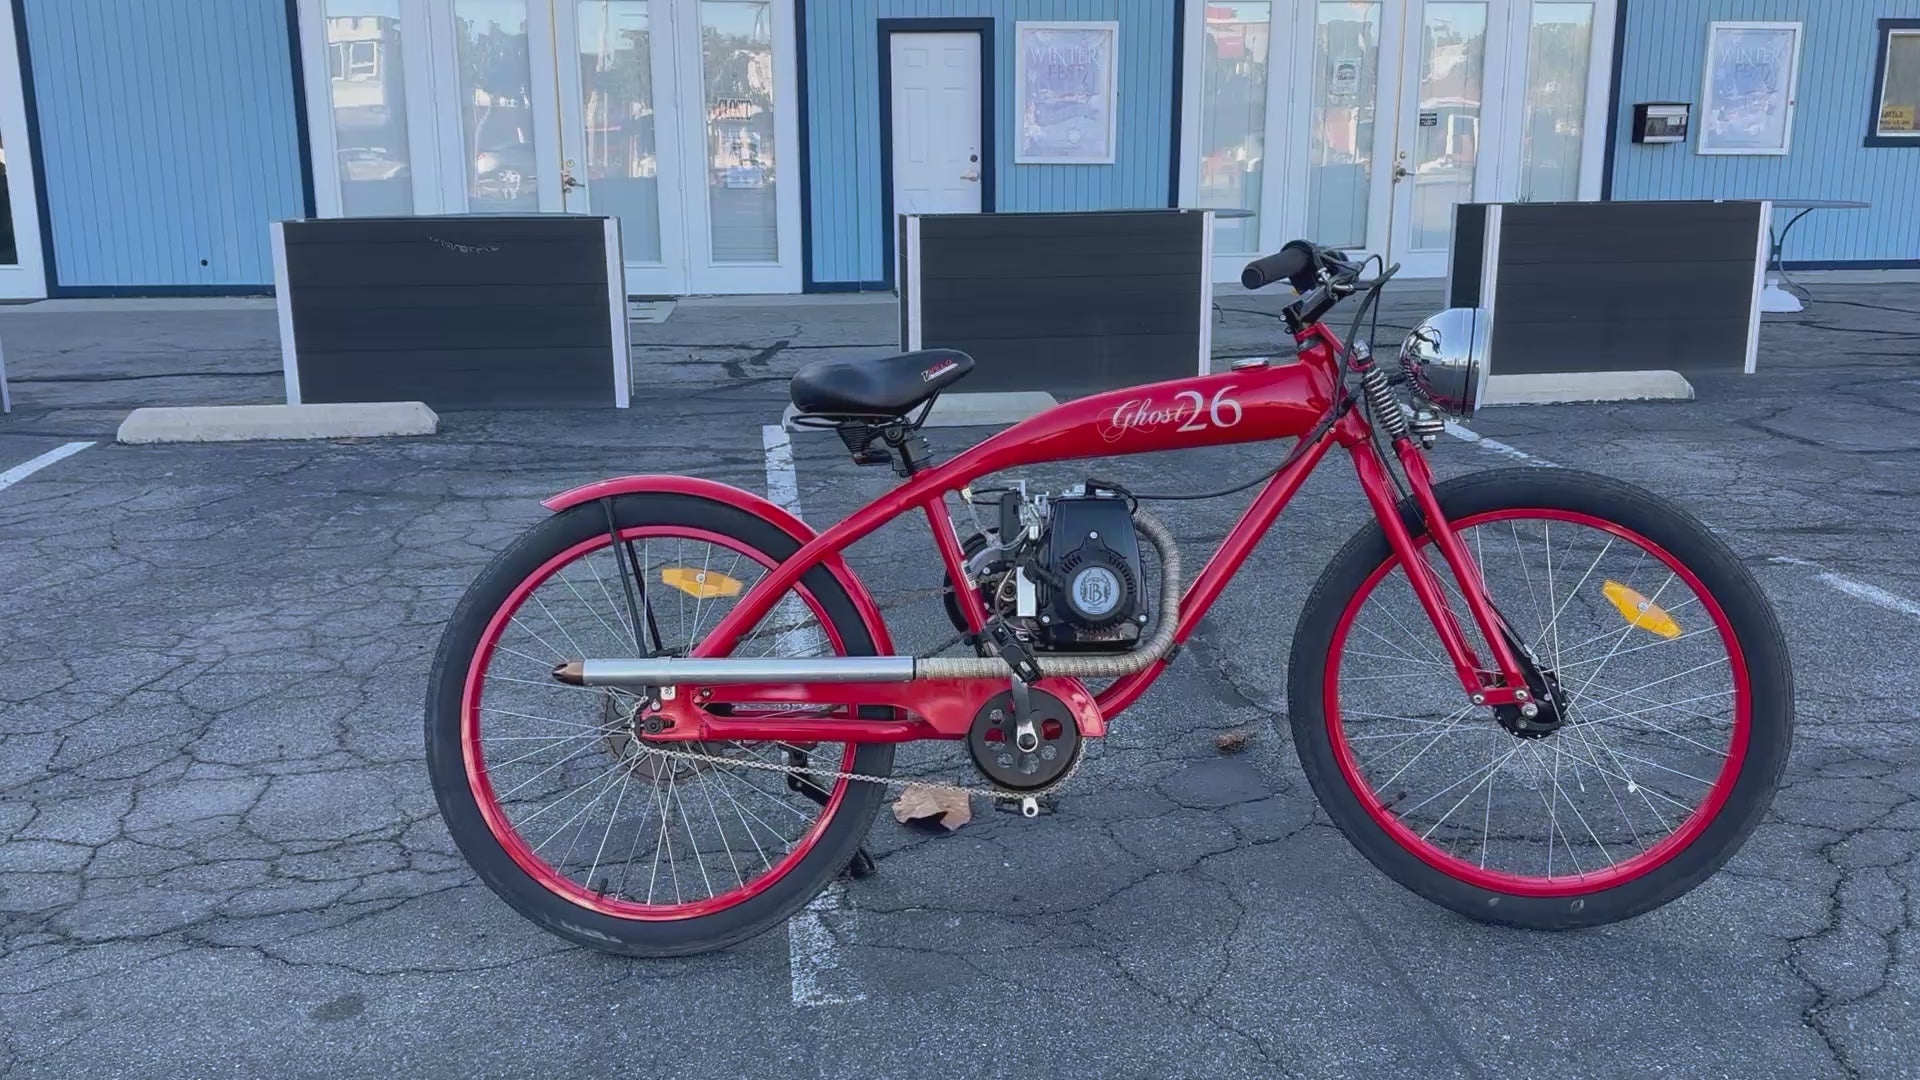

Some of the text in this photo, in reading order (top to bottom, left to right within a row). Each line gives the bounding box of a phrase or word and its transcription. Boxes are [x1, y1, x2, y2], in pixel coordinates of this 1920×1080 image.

[1029, 46, 1099, 66] WINTER
[1721, 46, 1782, 66] WINTER
[1097, 384, 1242, 443] Ghost 26
